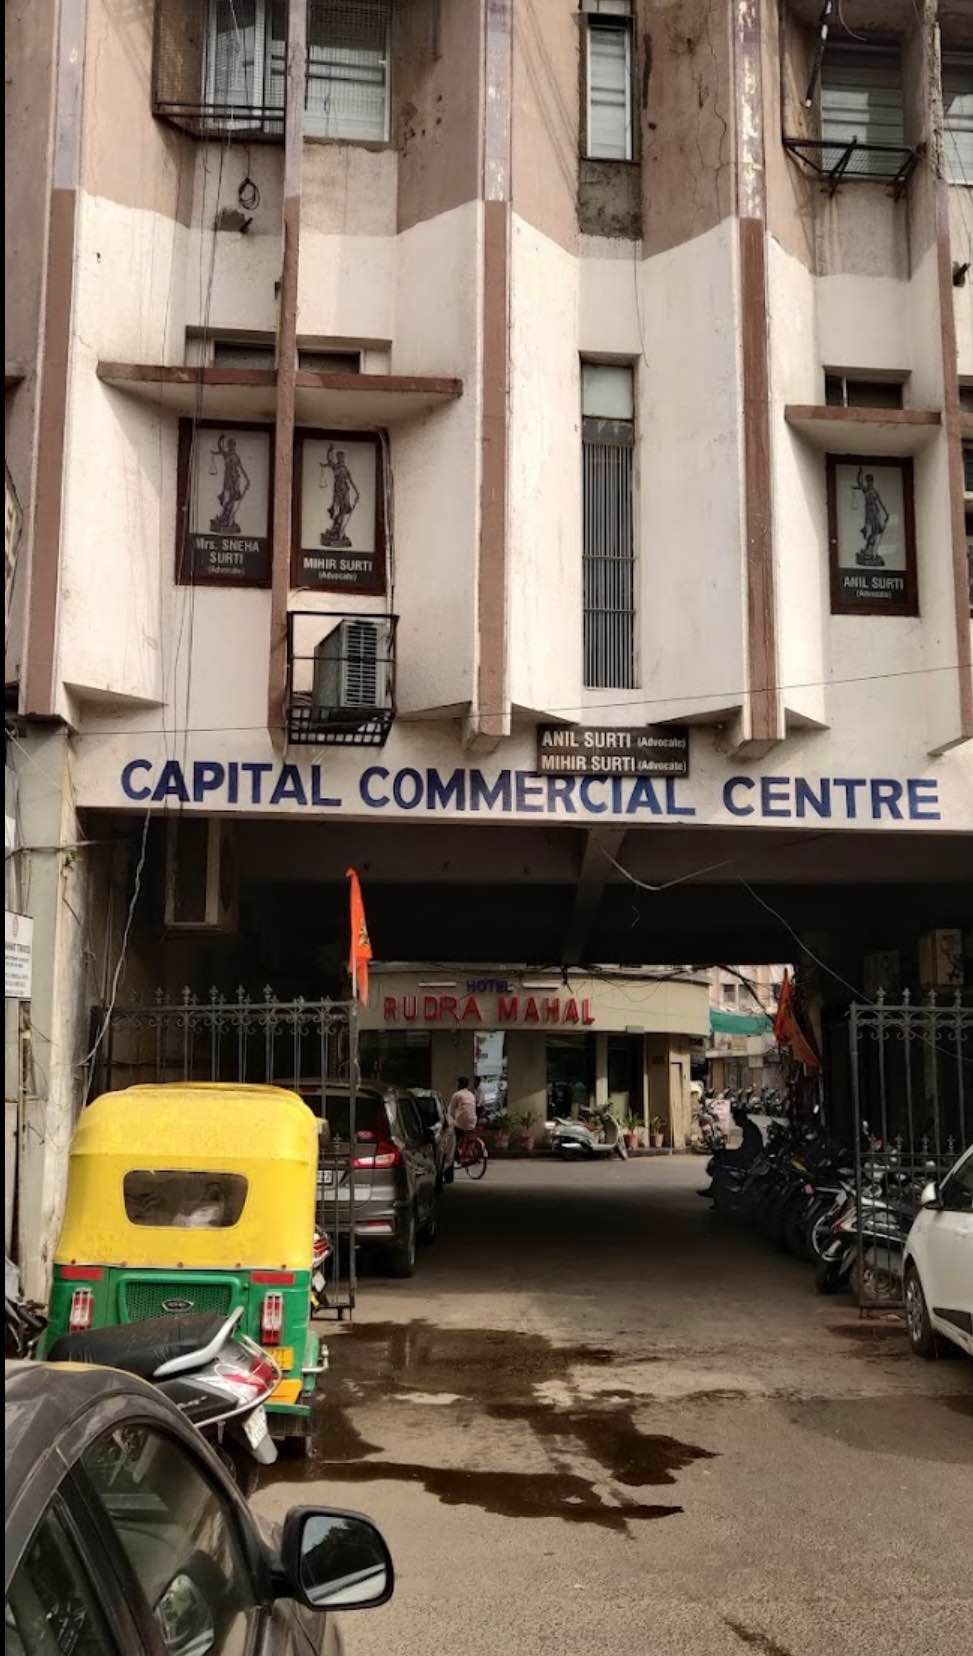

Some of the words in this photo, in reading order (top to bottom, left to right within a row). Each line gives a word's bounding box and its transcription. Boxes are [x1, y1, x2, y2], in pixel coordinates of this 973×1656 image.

[222, 540, 259, 552] SNEHA
[210, 552, 243, 564] SURTI
[303, 558, 336, 569] MIHIR
[340, 560, 373, 571] SURTI
[844, 576, 869, 588] ANIL
[872, 577, 904, 590] SURTI
[542, 731, 579, 747] ANIL
[584, 731, 631, 748] SURTI
[637, 736, 686, 748] (Advocate)
[542, 755, 586, 771] MIHIR
[591, 756, 636, 772] SURTI
[638, 760, 687, 772] (Advocate)
[121, 759, 342, 806] CAPITAL
[359, 766, 696, 815] COMMERCIAL
[723, 776, 942, 821] CENTRE
[466, 979, 513, 993] HOTEL
[383, 994, 483, 1023] RUDRA
[496, 996, 595, 1026] MAHAL
